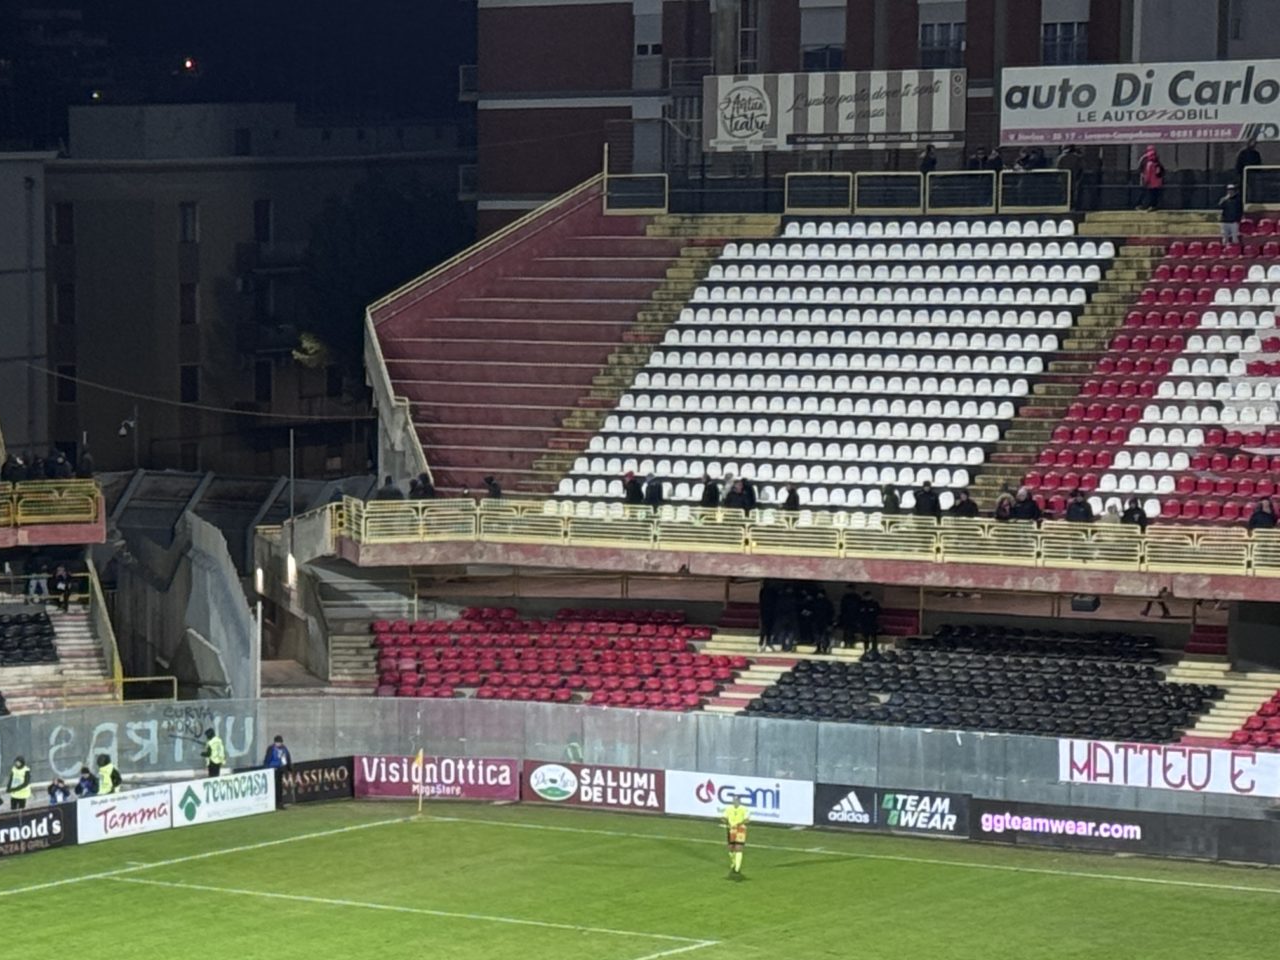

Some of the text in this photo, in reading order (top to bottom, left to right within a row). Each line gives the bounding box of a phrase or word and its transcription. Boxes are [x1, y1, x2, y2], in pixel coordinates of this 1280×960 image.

[1005, 65, 1280, 110] auto Di Carlo
[1077, 112, 1097, 123] LE
[282, 766, 349, 788] MASSIMO
[580, 768, 657, 790] SALUMI
[203, 773, 269, 804] TECNOCASA
[580, 785, 660, 808] DE LUCA
[895, 794, 951, 814] TEAM
[94, 802, 168, 835] Tamma
[828, 811, 870, 824] adidas
[899, 810, 957, 831] WEAR
[981, 812, 1142, 840] ggteamwear.com
